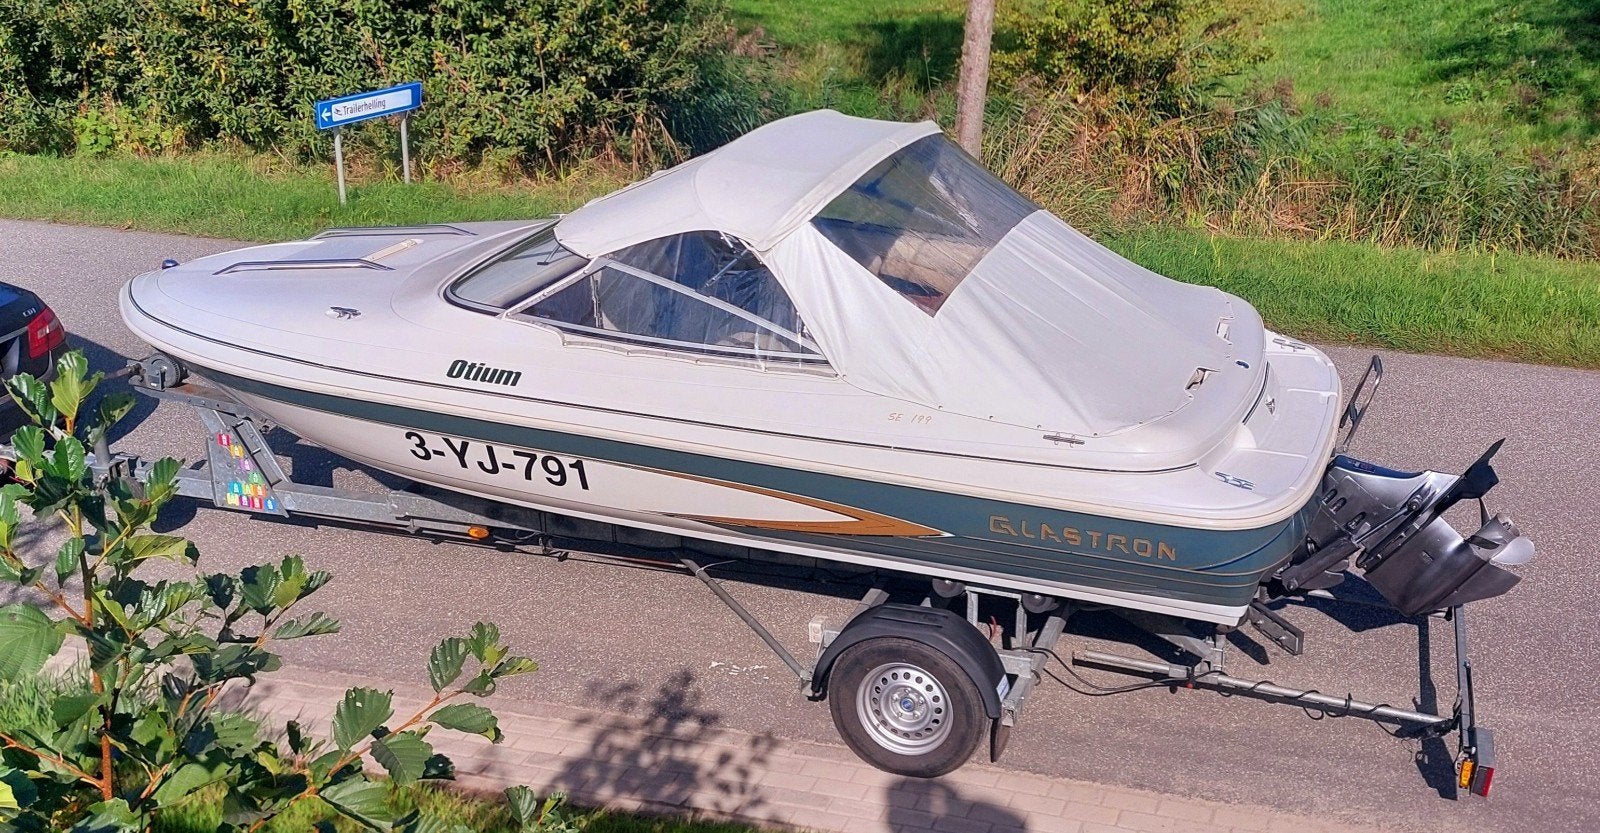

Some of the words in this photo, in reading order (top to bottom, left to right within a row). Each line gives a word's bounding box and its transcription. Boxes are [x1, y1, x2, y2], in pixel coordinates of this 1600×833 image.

[343, 99, 386, 115] Trailerhelling
[23, 308, 36, 317] CDI
[447, 359, 522, 387] Otium
[888, 413, 904, 422] SE
[911, 414, 932, 425] 199
[405, 431, 589, 490] 3-YJ-791
[989, 514, 1177, 561] GLASTRON
